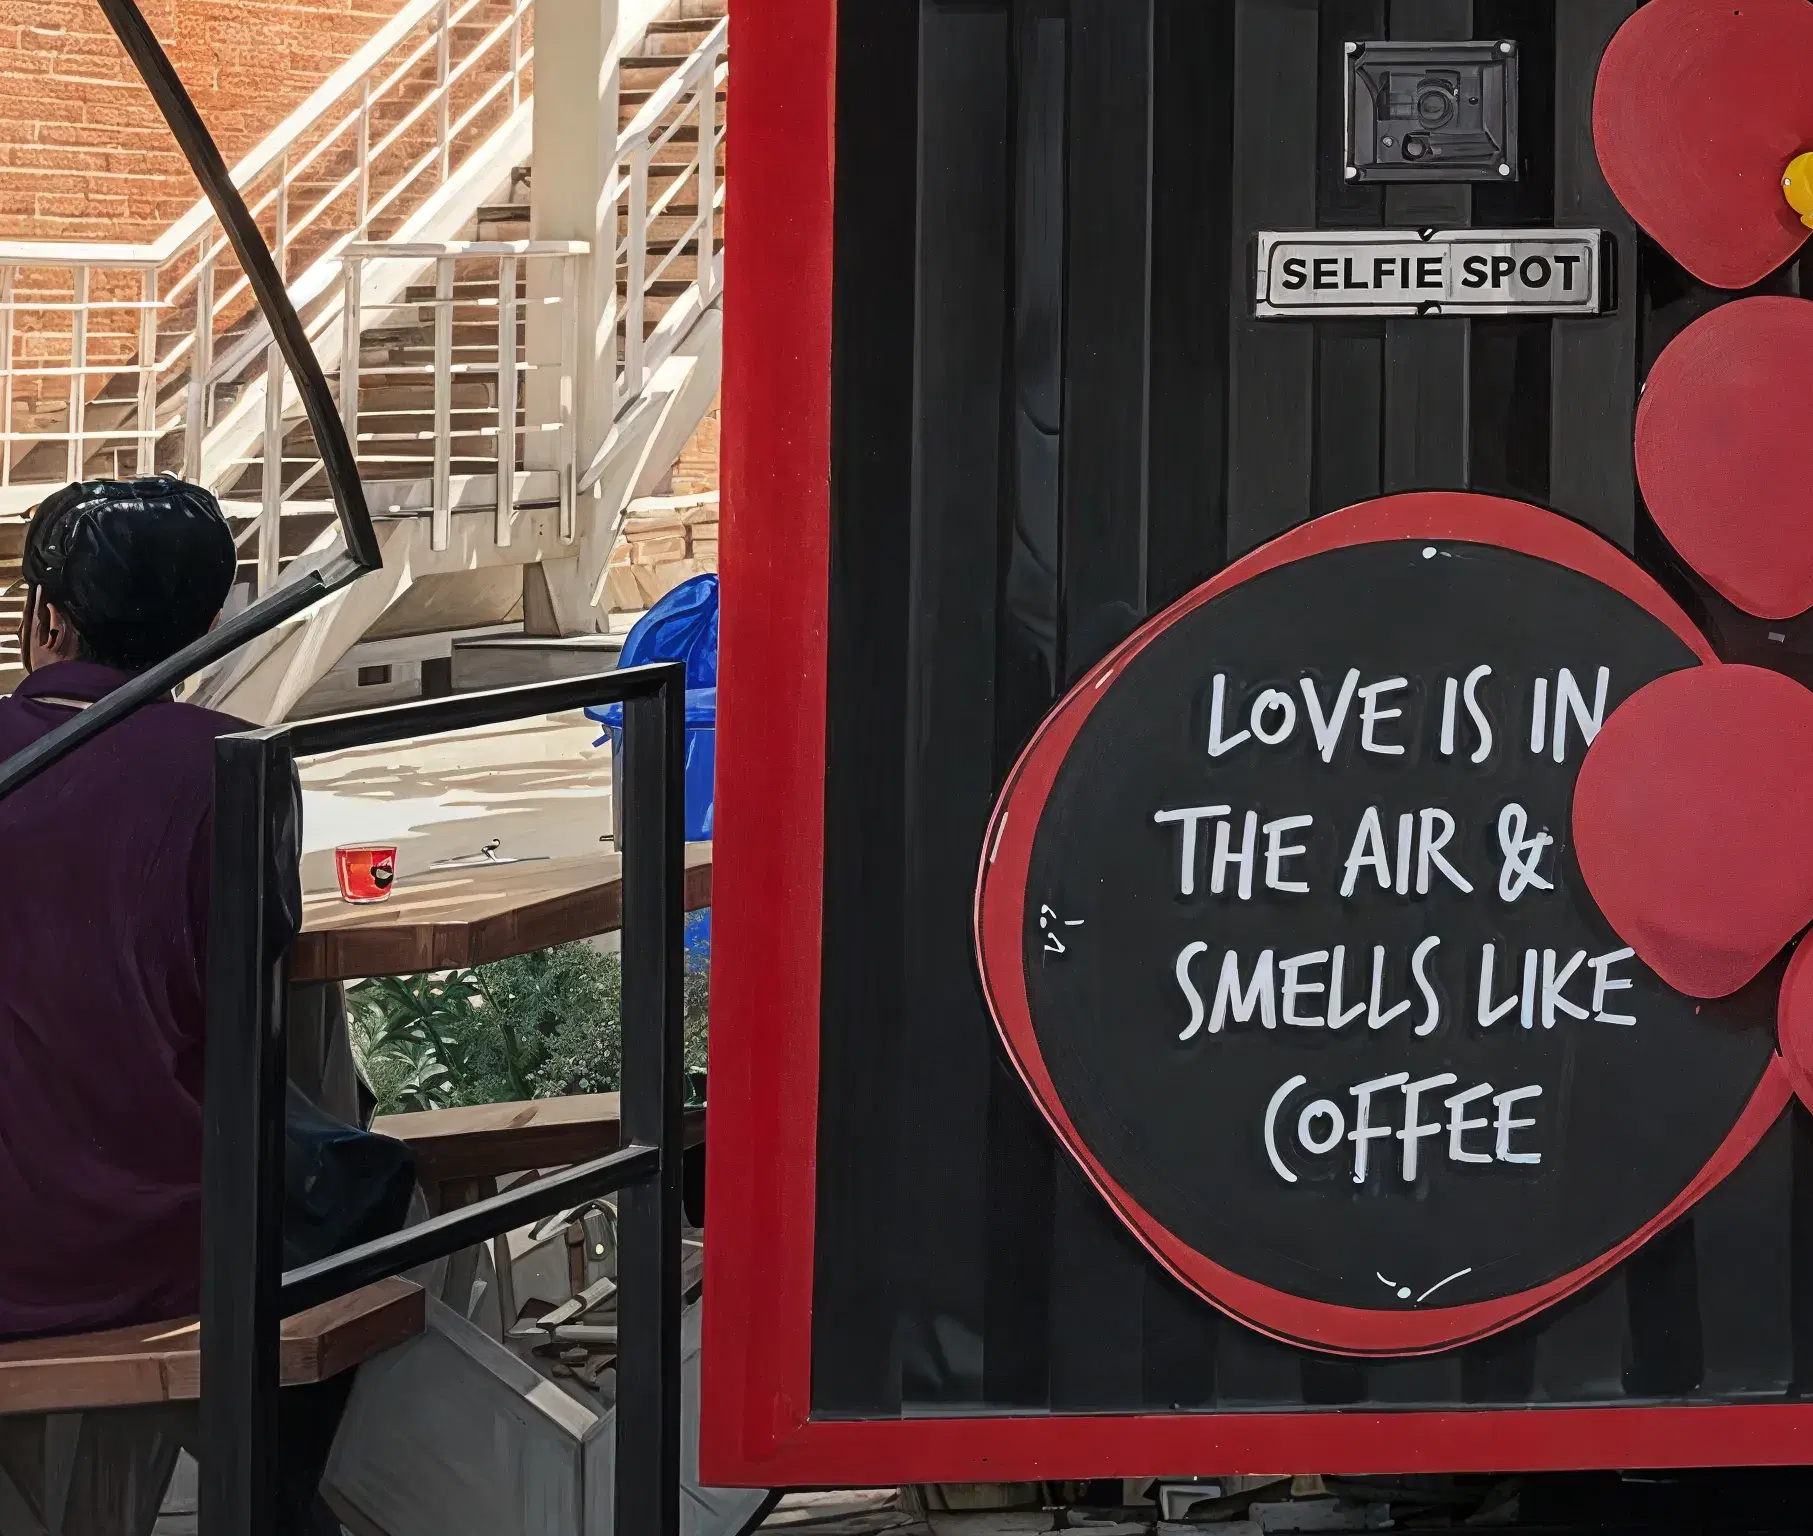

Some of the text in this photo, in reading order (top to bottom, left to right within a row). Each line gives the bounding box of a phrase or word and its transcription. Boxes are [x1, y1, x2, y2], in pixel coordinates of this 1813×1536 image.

[1281, 254, 1582, 291] SELFIE SPOT
[1207, 664, 1609, 764] LOVE IS IN
[1153, 801, 1555, 903] THE AIR &
[1173, 935, 1637, 1042] SMELLS LIKE
[1263, 1072, 1545, 1185] COFFEE
